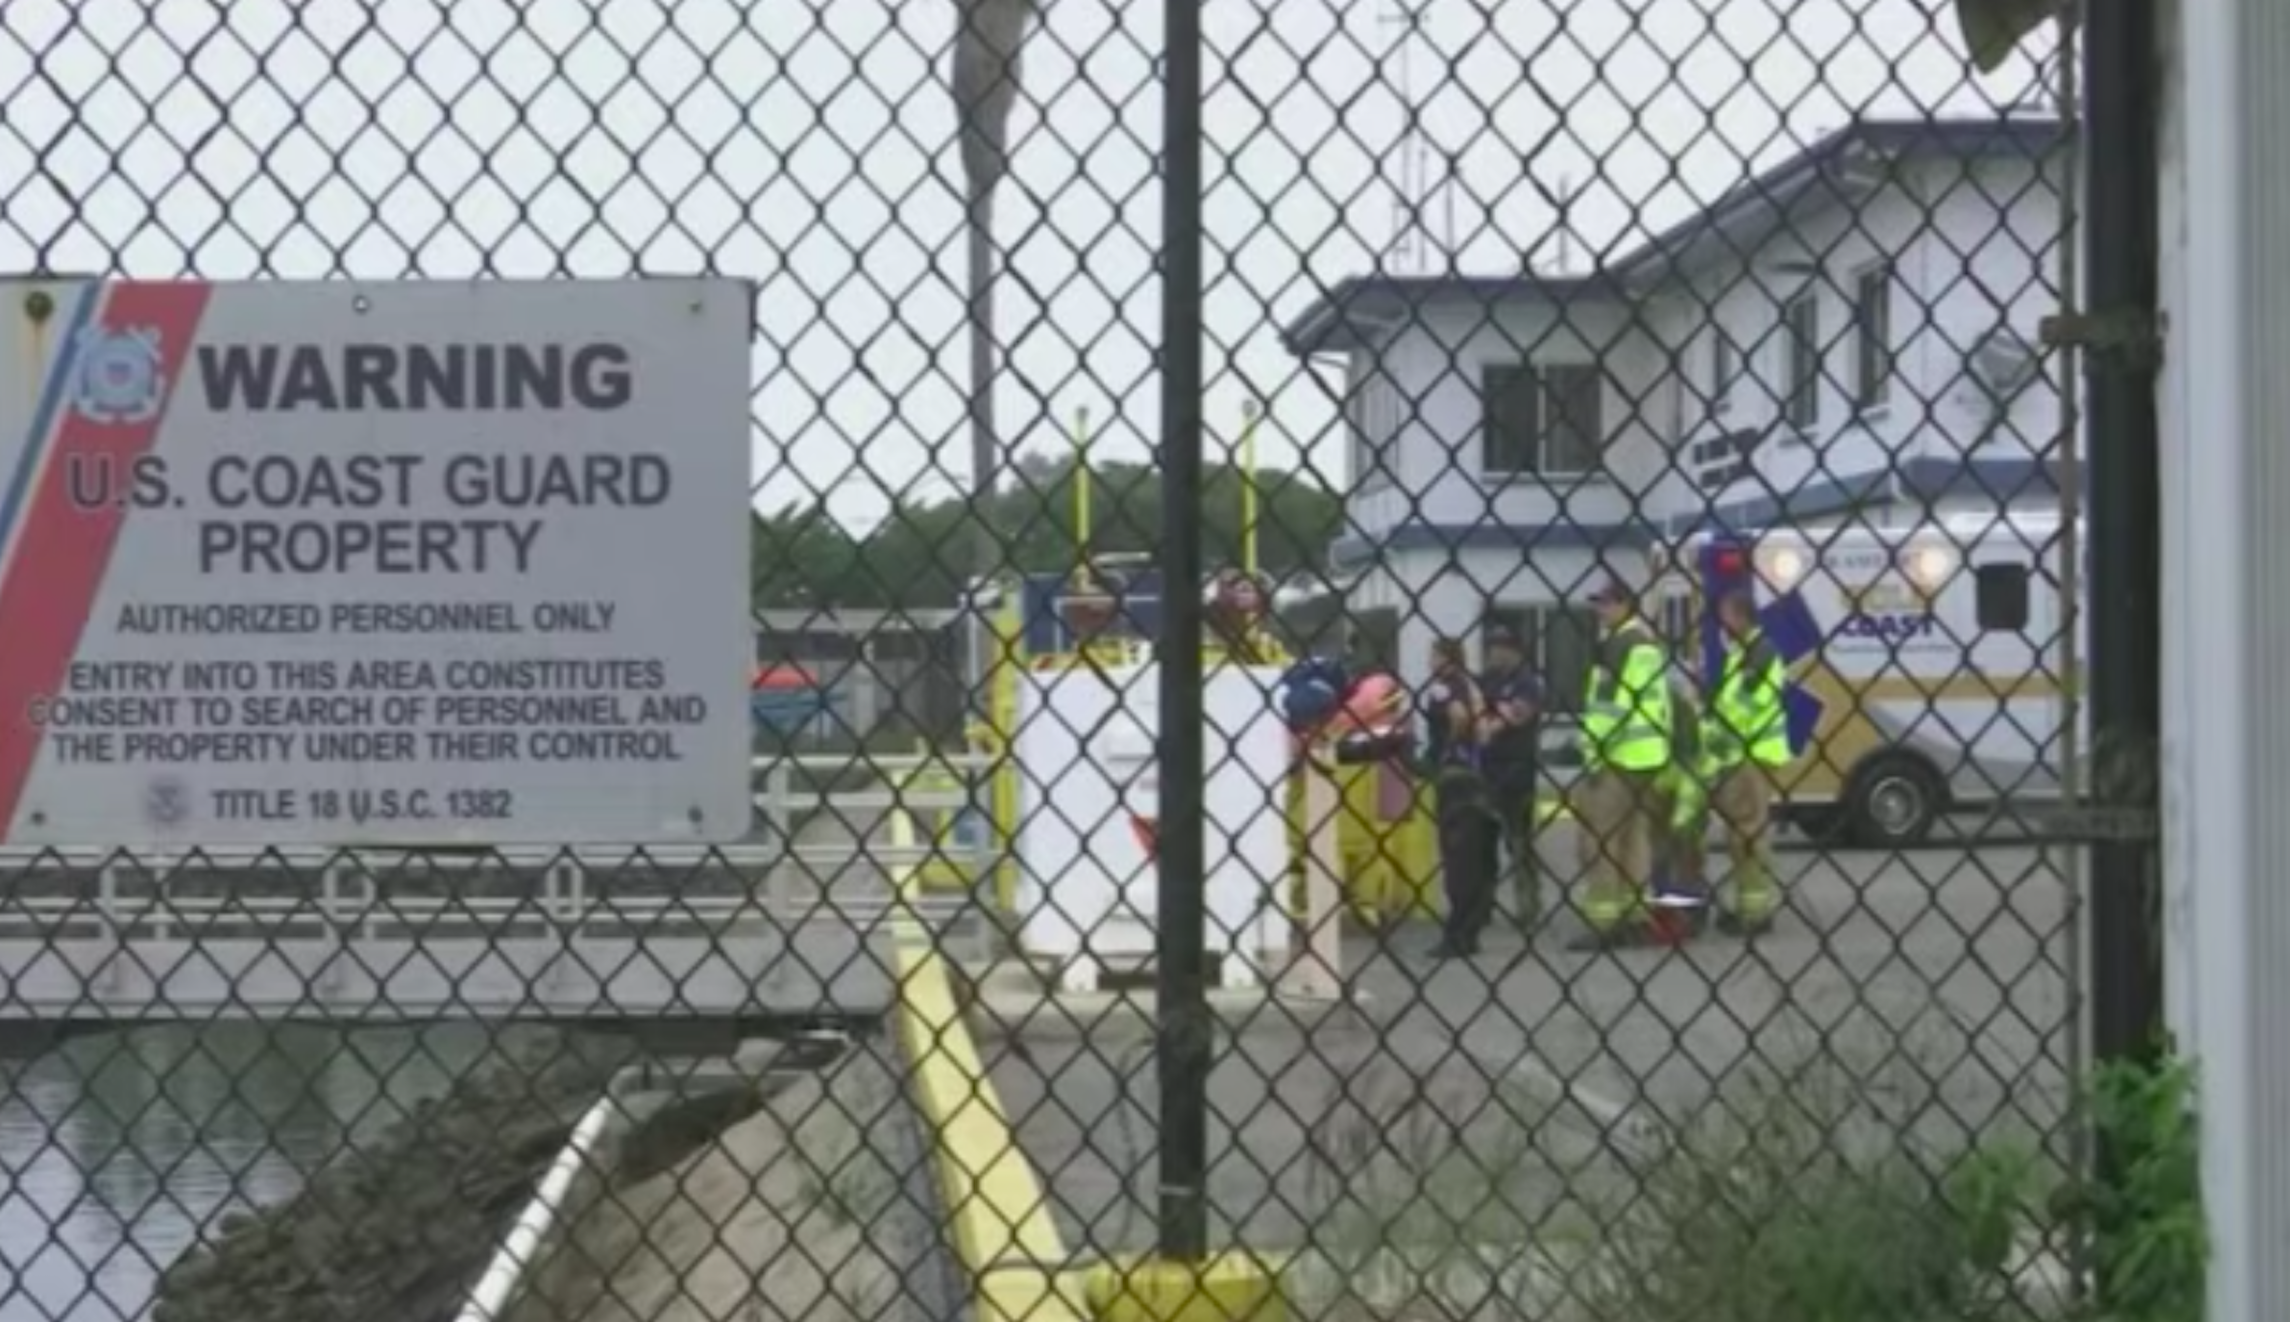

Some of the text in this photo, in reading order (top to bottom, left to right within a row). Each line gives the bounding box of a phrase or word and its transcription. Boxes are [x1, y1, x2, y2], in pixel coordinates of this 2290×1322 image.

[199, 343, 633, 412] WARNING
[70, 454, 671, 508] U.S. COAST GUARD
[200, 520, 544, 574] PROPERTY
[117, 602, 615, 634] AUTHORIZED PERSONNEL ONLY
[69, 660, 665, 691] ENTRY INTO THIS AREA CONSTITUTES
[29, 695, 706, 727] CONSENT TO SEARCH OF PERSONNEL AND
[53, 731, 682, 763] THE PROPERTY UNDER THEIR CONTROL
[212, 789, 513, 822] TITLE 18 U.S.C. 1382
